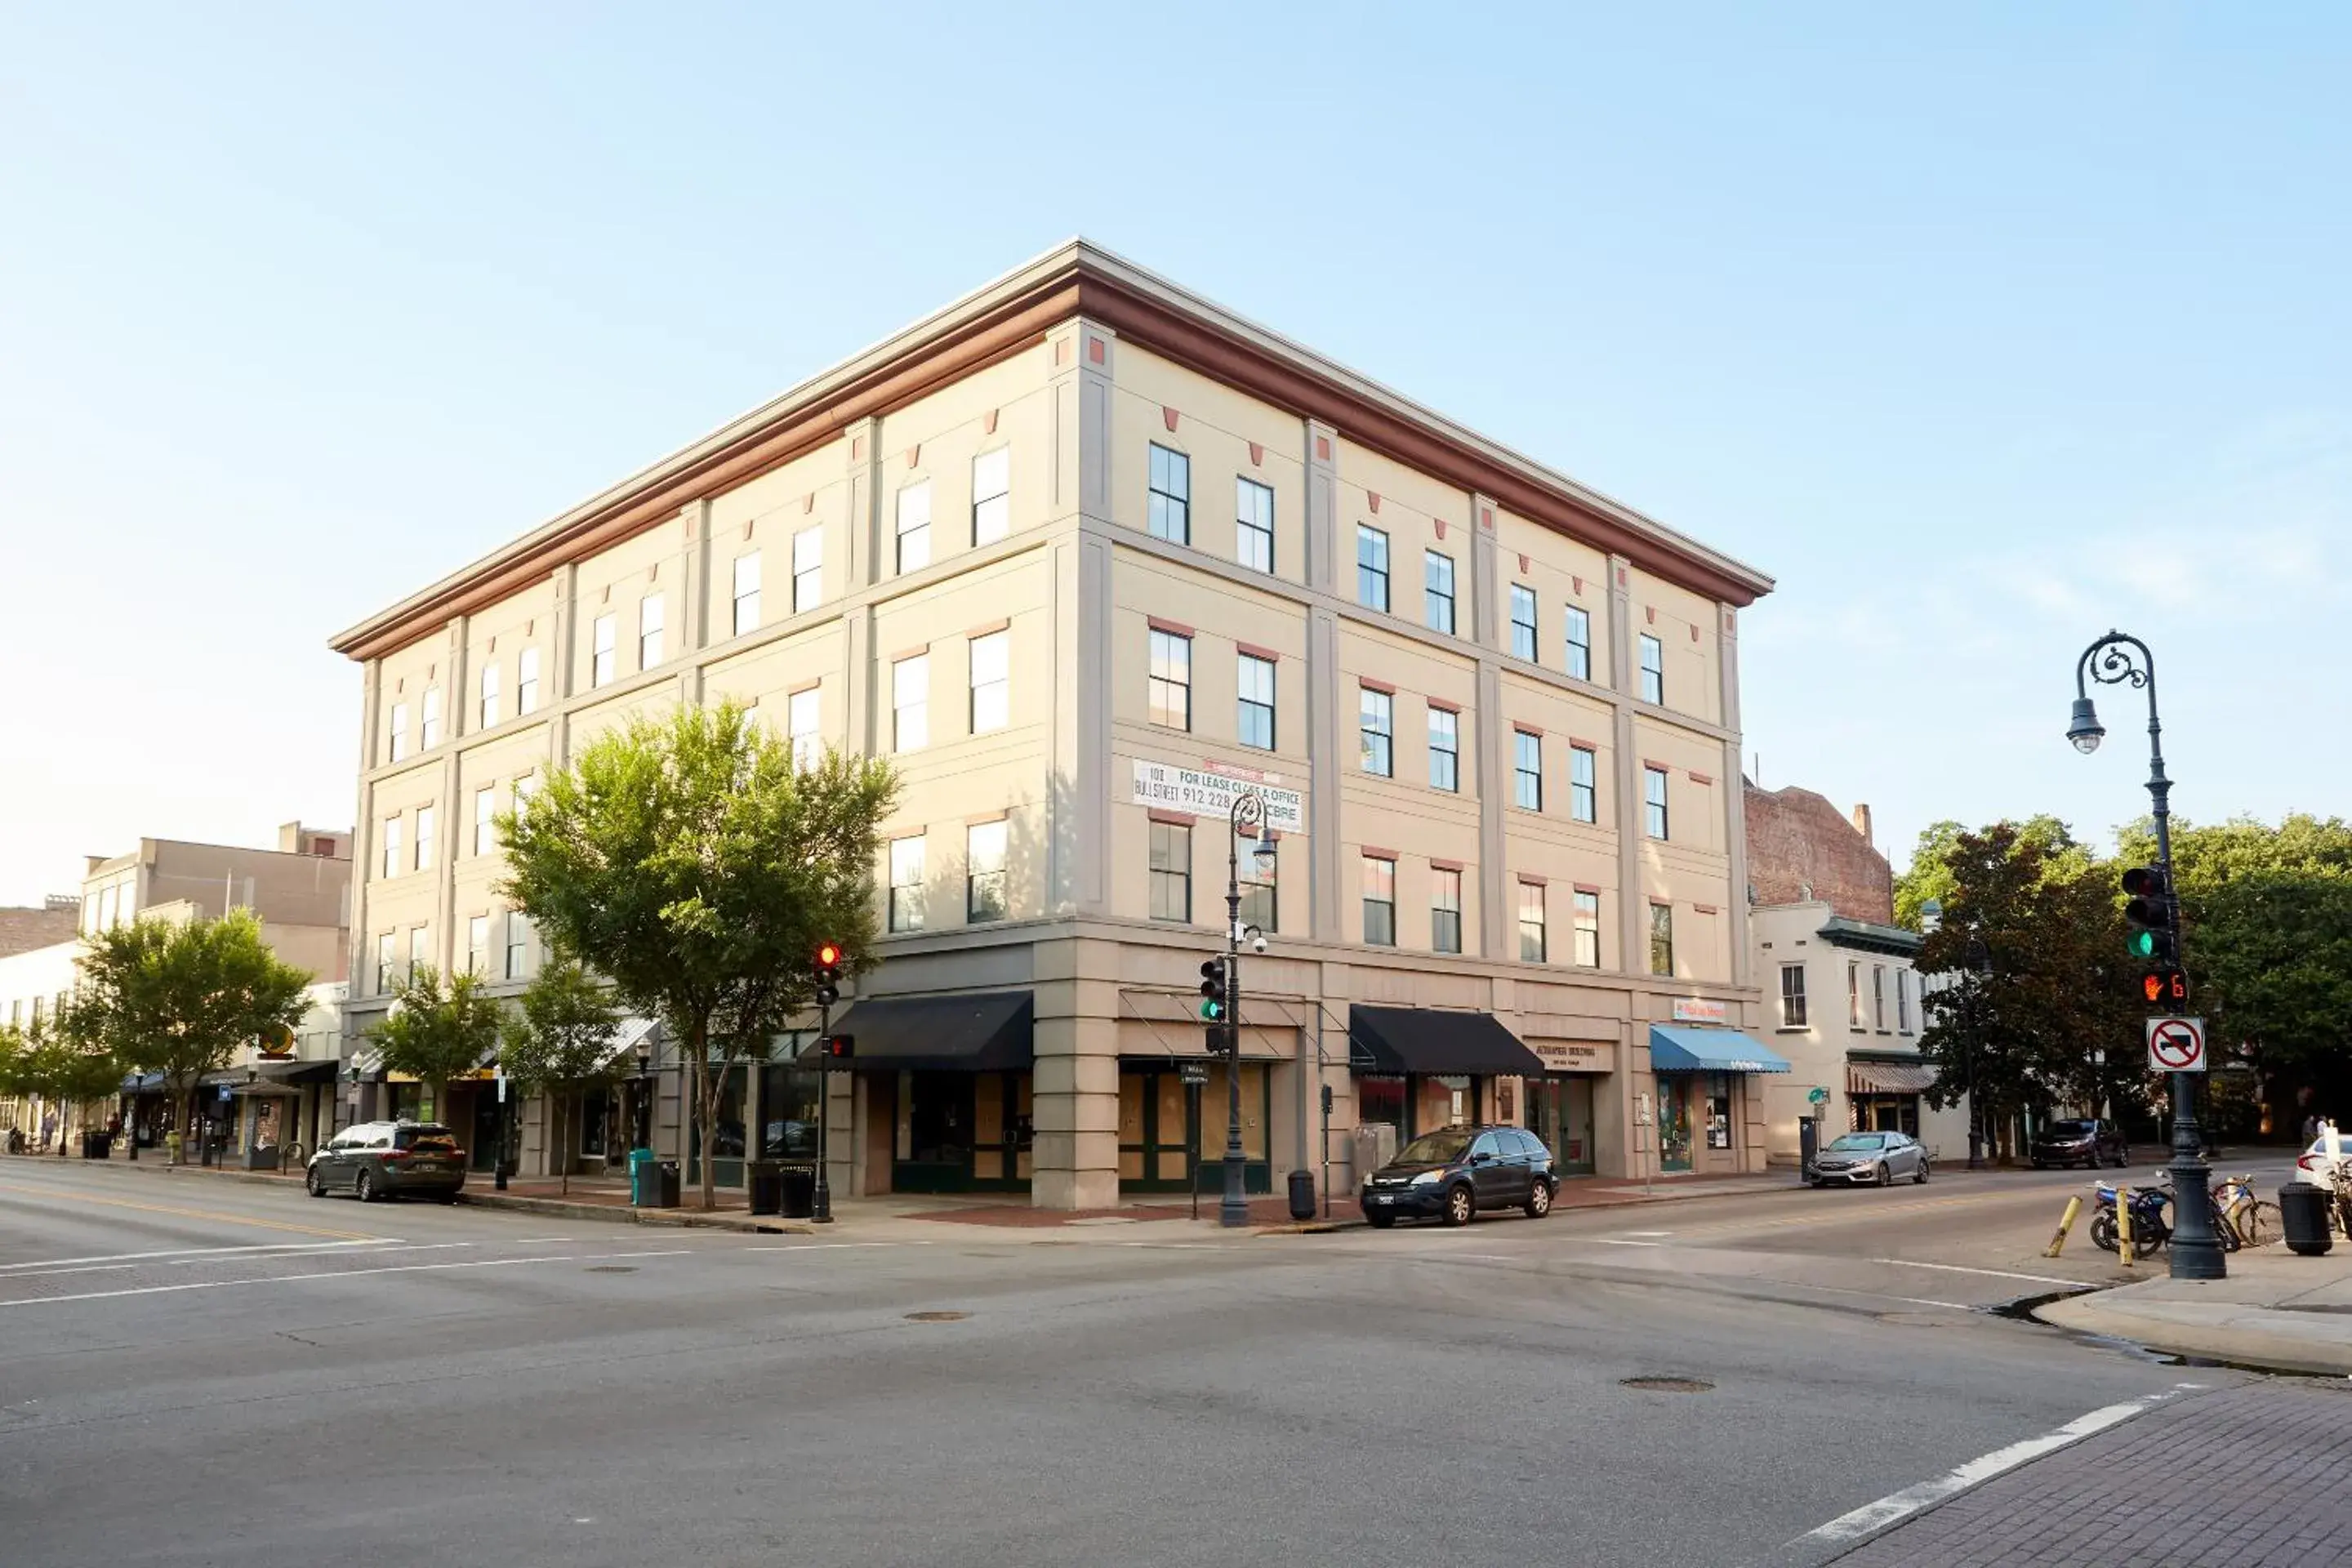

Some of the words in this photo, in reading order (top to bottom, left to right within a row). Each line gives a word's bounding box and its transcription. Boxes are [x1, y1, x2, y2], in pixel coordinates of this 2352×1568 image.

[1151, 768, 1165, 782] 101
[1153, 783, 1178, 801] STREET
[1180, 771, 1199, 786] FOR
[1202, 774, 1230, 791] LEASE
[1271, 790, 1300, 804] OFFICE
[1183, 787, 1205, 804] 912
[1208, 792, 1230, 808] 228
[1266, 804, 1297, 819] CBRE
[2172, 975, 2184, 997] 6
